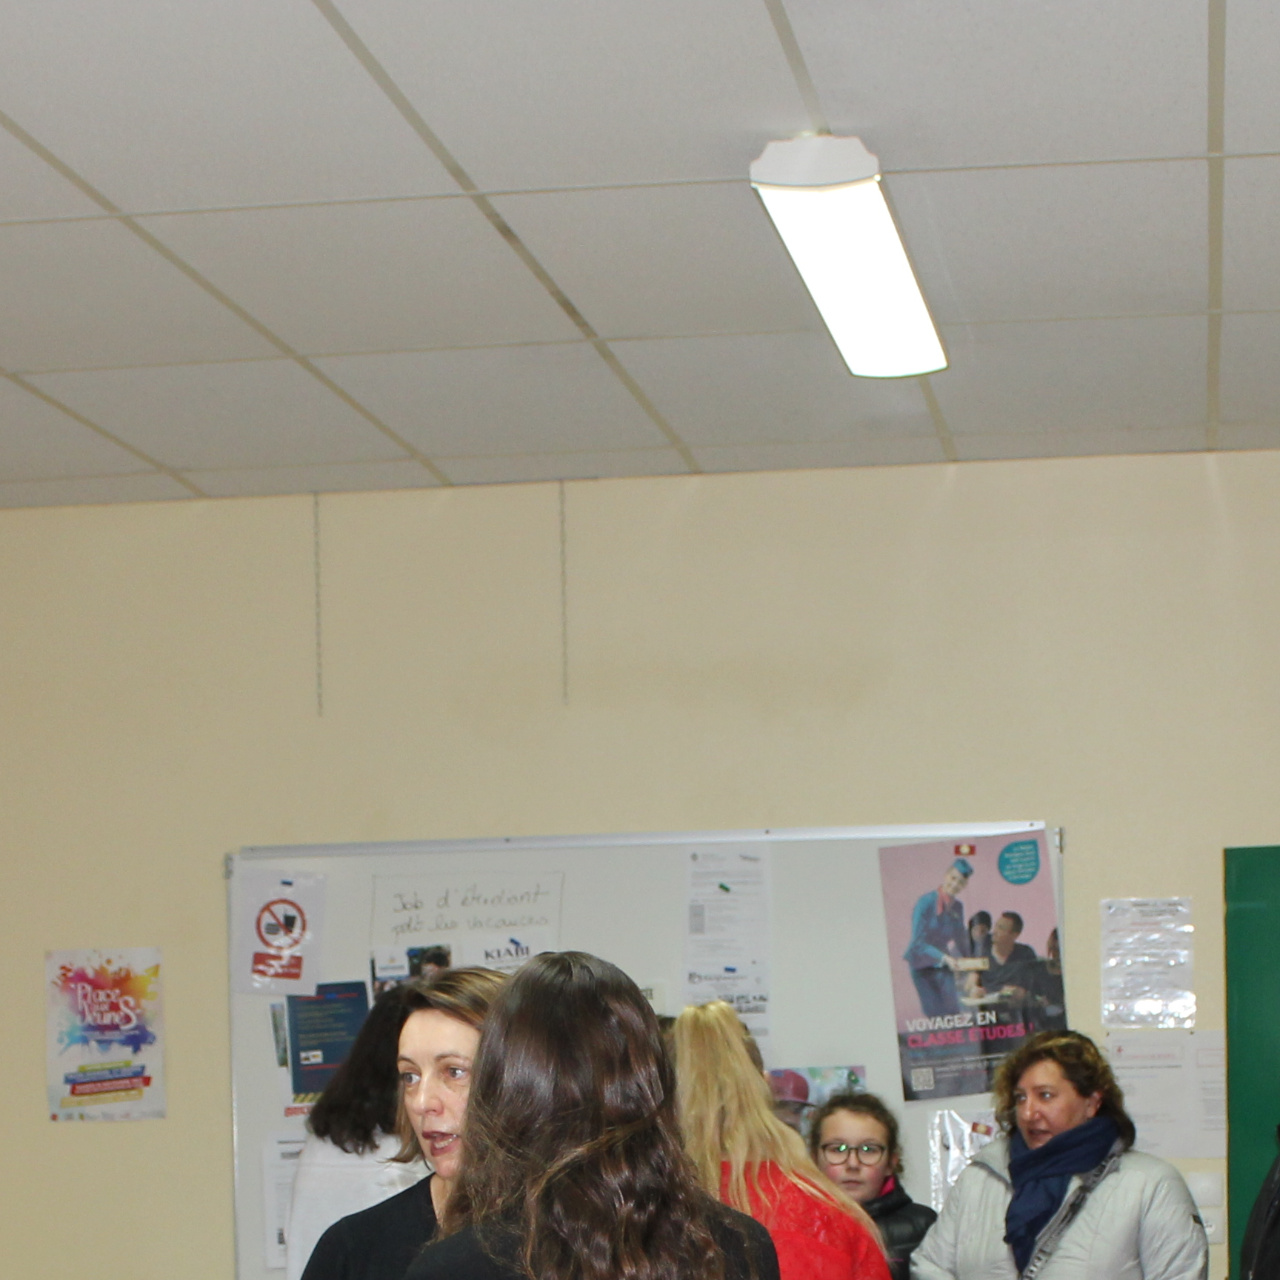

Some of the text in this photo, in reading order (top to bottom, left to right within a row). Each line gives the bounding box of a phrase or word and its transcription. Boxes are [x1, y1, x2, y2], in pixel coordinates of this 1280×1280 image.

[906, 1010, 998, 1032] VOYAGEZ EN
[907, 1029, 966, 1048] CLASSE
